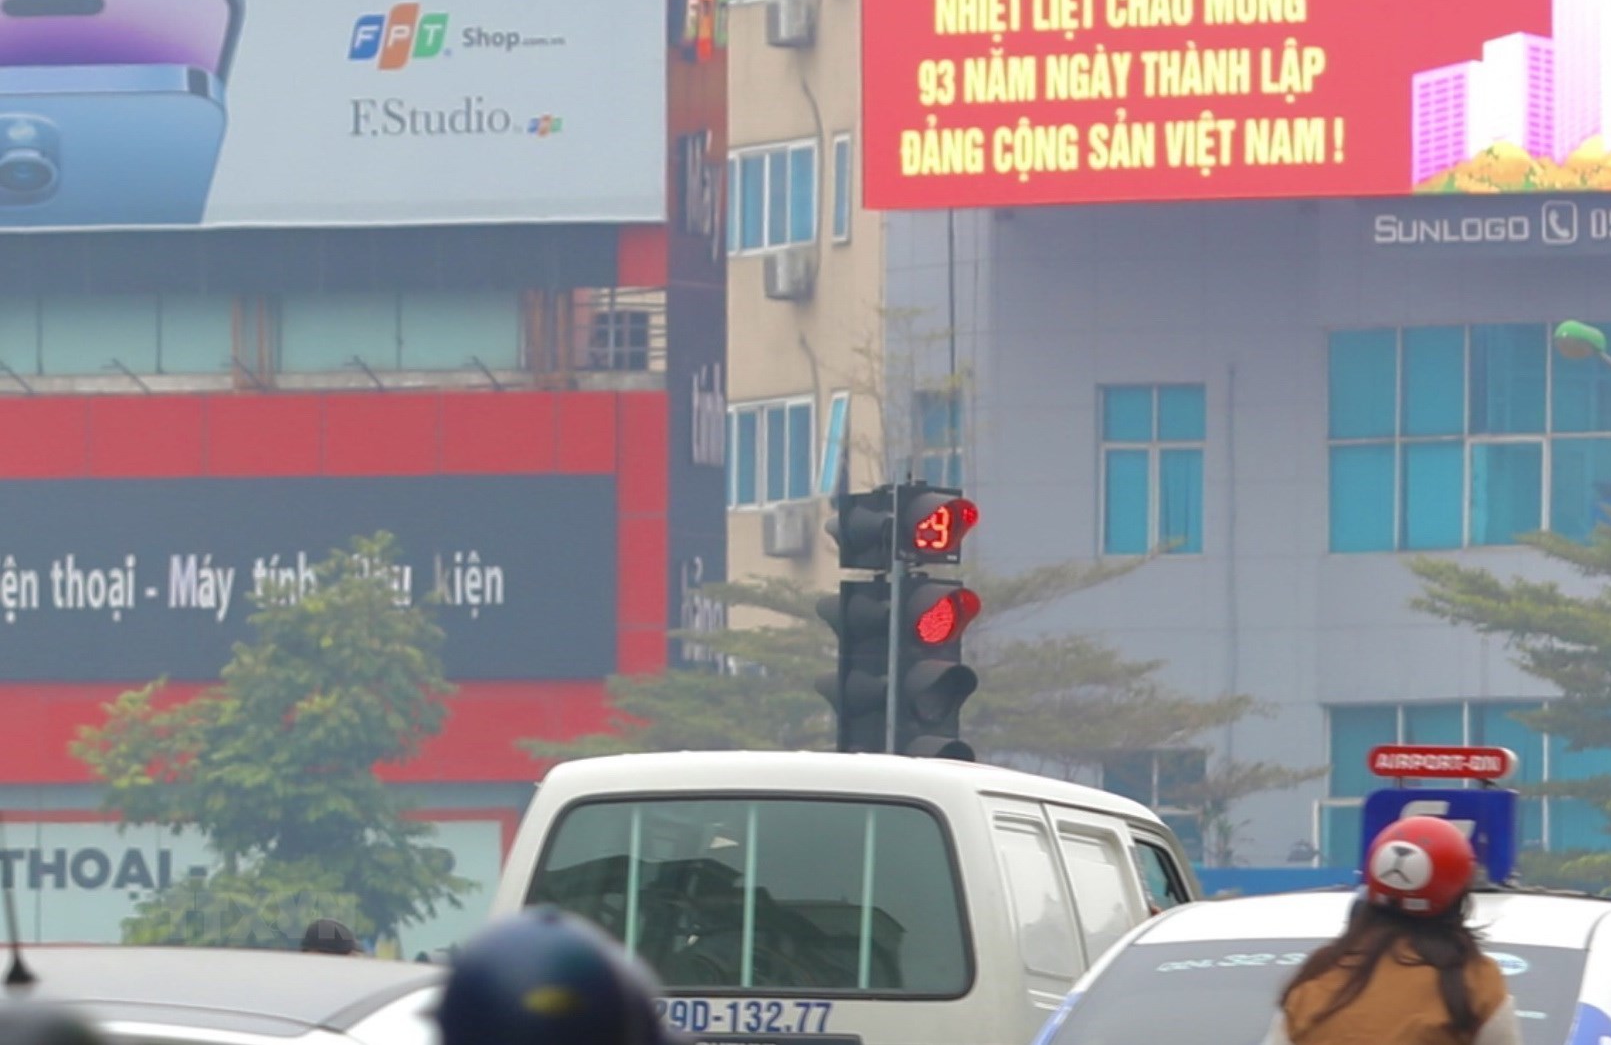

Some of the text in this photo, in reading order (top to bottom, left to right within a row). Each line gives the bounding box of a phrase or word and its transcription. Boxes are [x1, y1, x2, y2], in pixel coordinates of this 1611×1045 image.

[917, 36, 1327, 107] 93 NĂM NGÀY THÀNH LẬP
[349, 96, 512, 137] F.Studio
[899, 114, 985, 177] ĐẢNG
[992, 116, 1080, 182] CỘNG
[1087, 107, 1155, 170] SẢN
[1164, 109, 1237, 177] VIỆT
[1243, 117, 1326, 166] NAM
[1373, 215, 1531, 244] SUNLOGO
[49, 552, 137, 623] thoại
[168, 552, 236, 623] Máy
[433, 549, 505, 620] kiện
[0, 847, 173, 901] THOẠI
